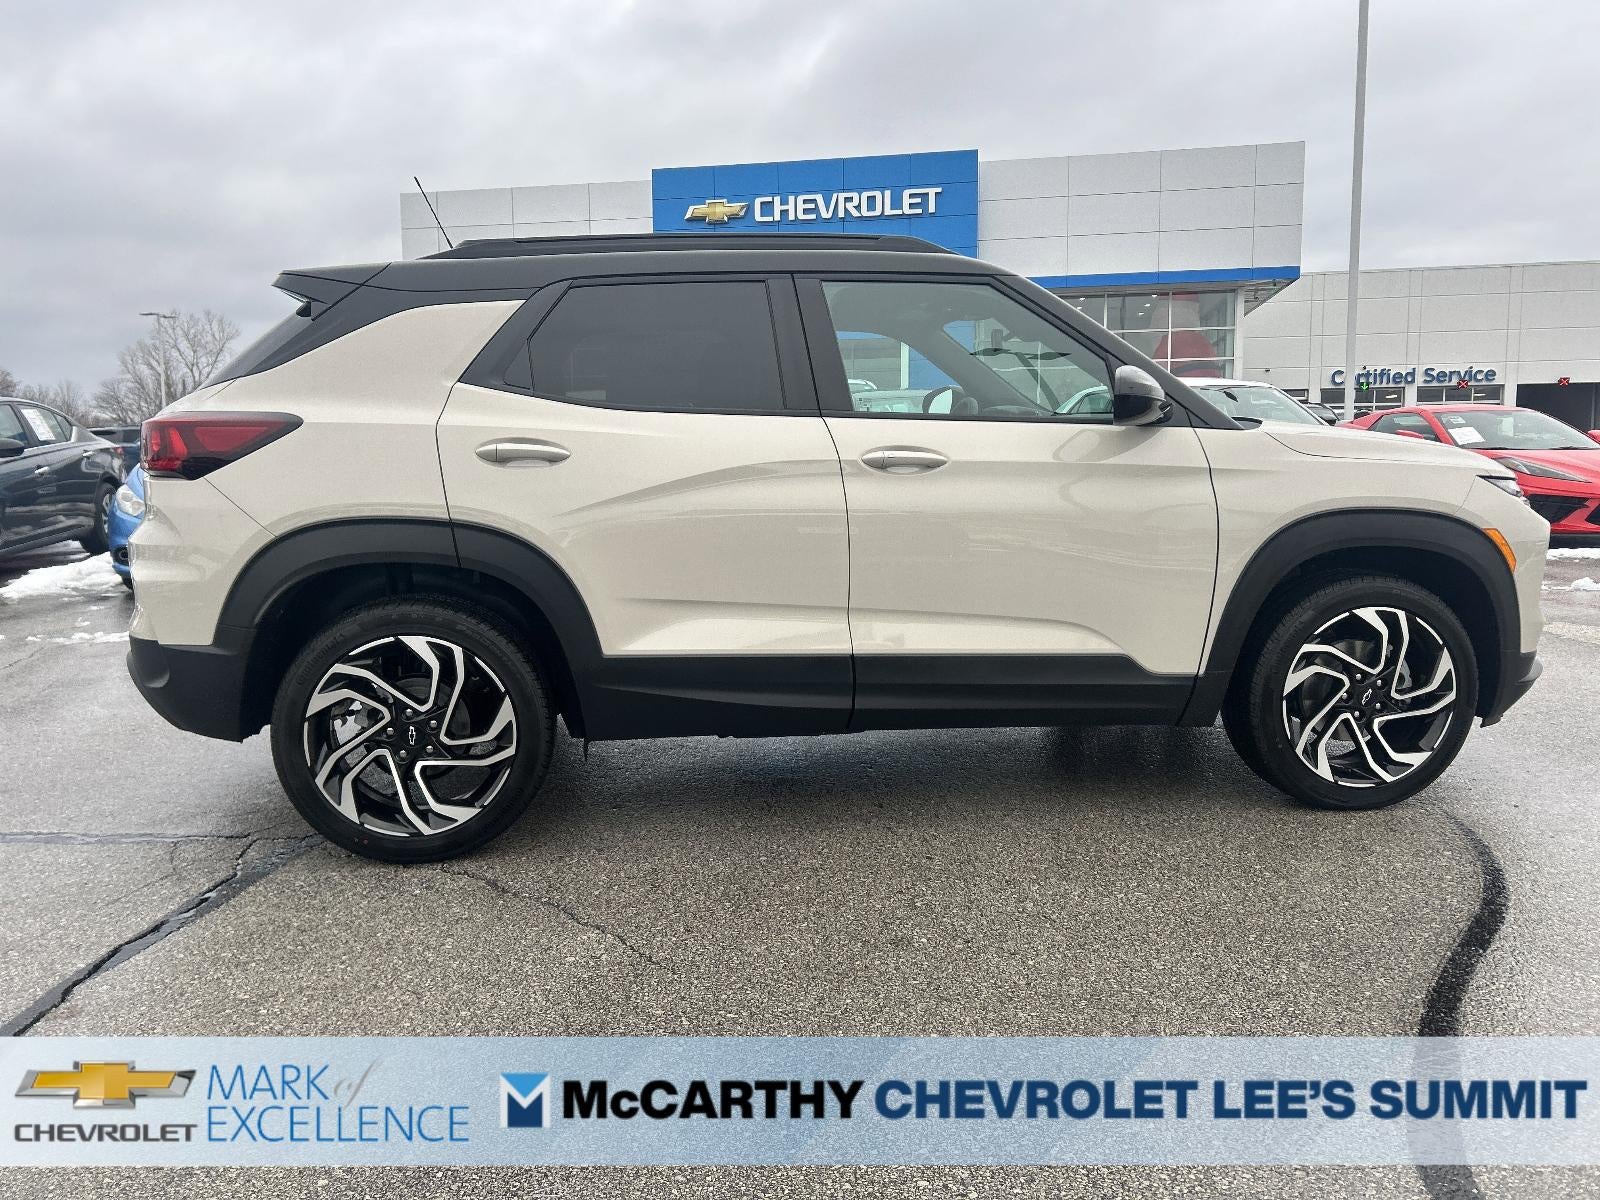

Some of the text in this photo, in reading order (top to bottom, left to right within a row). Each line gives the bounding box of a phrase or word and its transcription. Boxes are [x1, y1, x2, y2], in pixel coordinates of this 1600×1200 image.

[754, 187, 942, 222] CHEVROLET
[1331, 366, 1497, 385] Crtified Service
